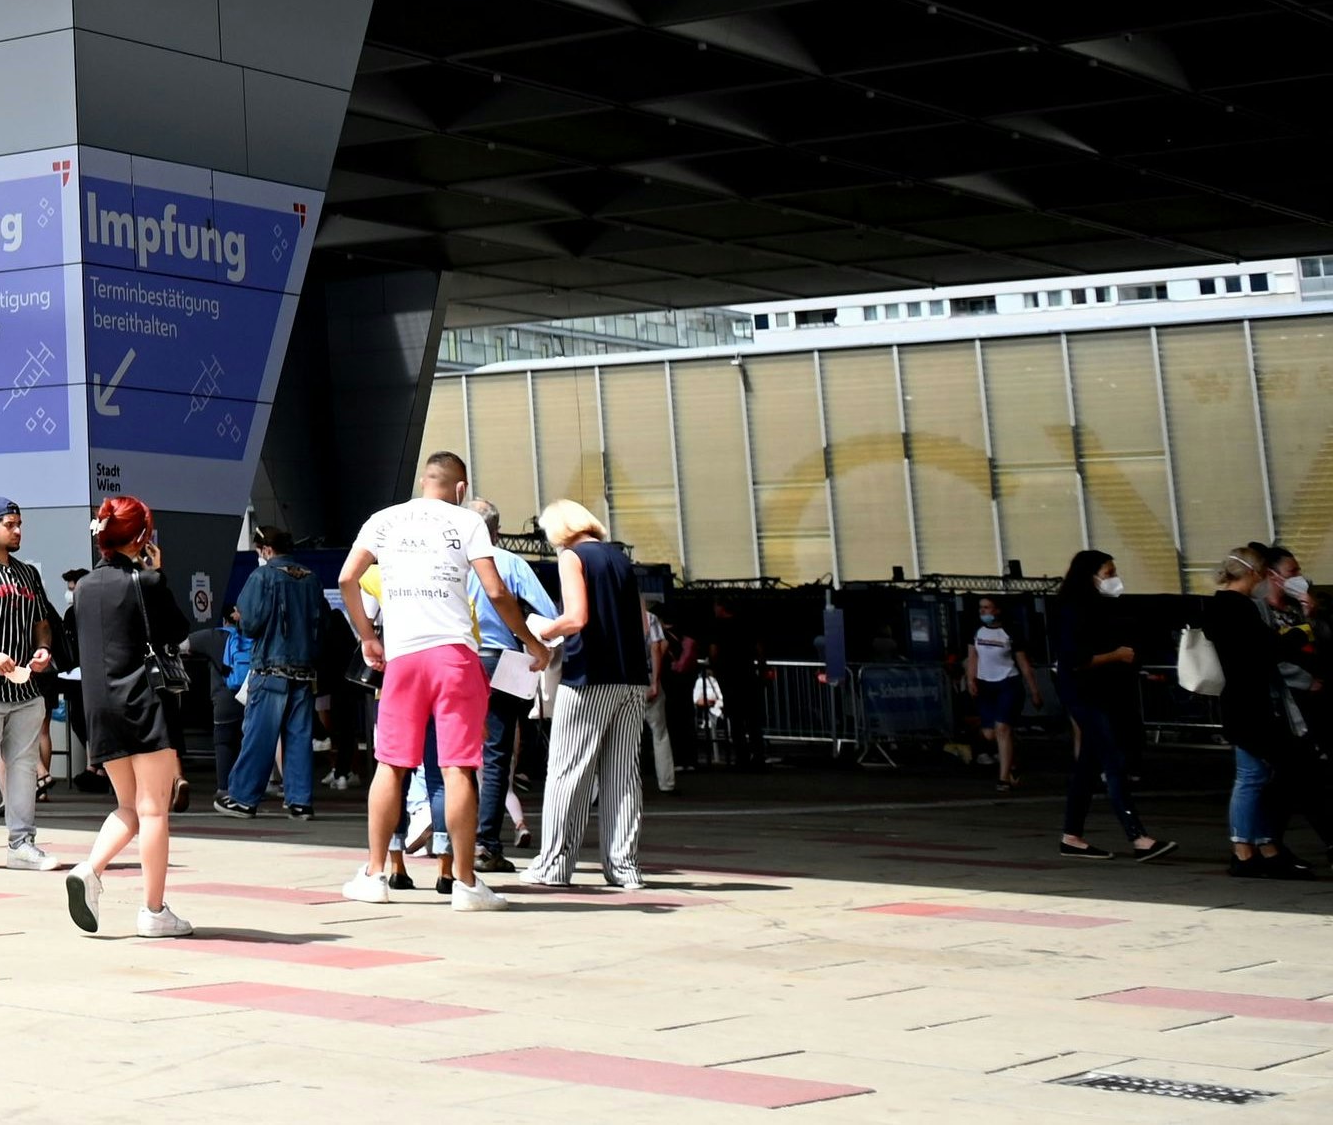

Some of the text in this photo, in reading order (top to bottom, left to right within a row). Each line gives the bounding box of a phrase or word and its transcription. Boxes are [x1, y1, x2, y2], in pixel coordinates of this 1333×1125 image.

[87, 192, 247, 282] Impfung
[90, 276, 220, 320] Terminbestätigung
[93, 308, 178, 340] bereithalten
[96, 462, 121, 478] Stadt
[96, 478, 121, 493] Wien
